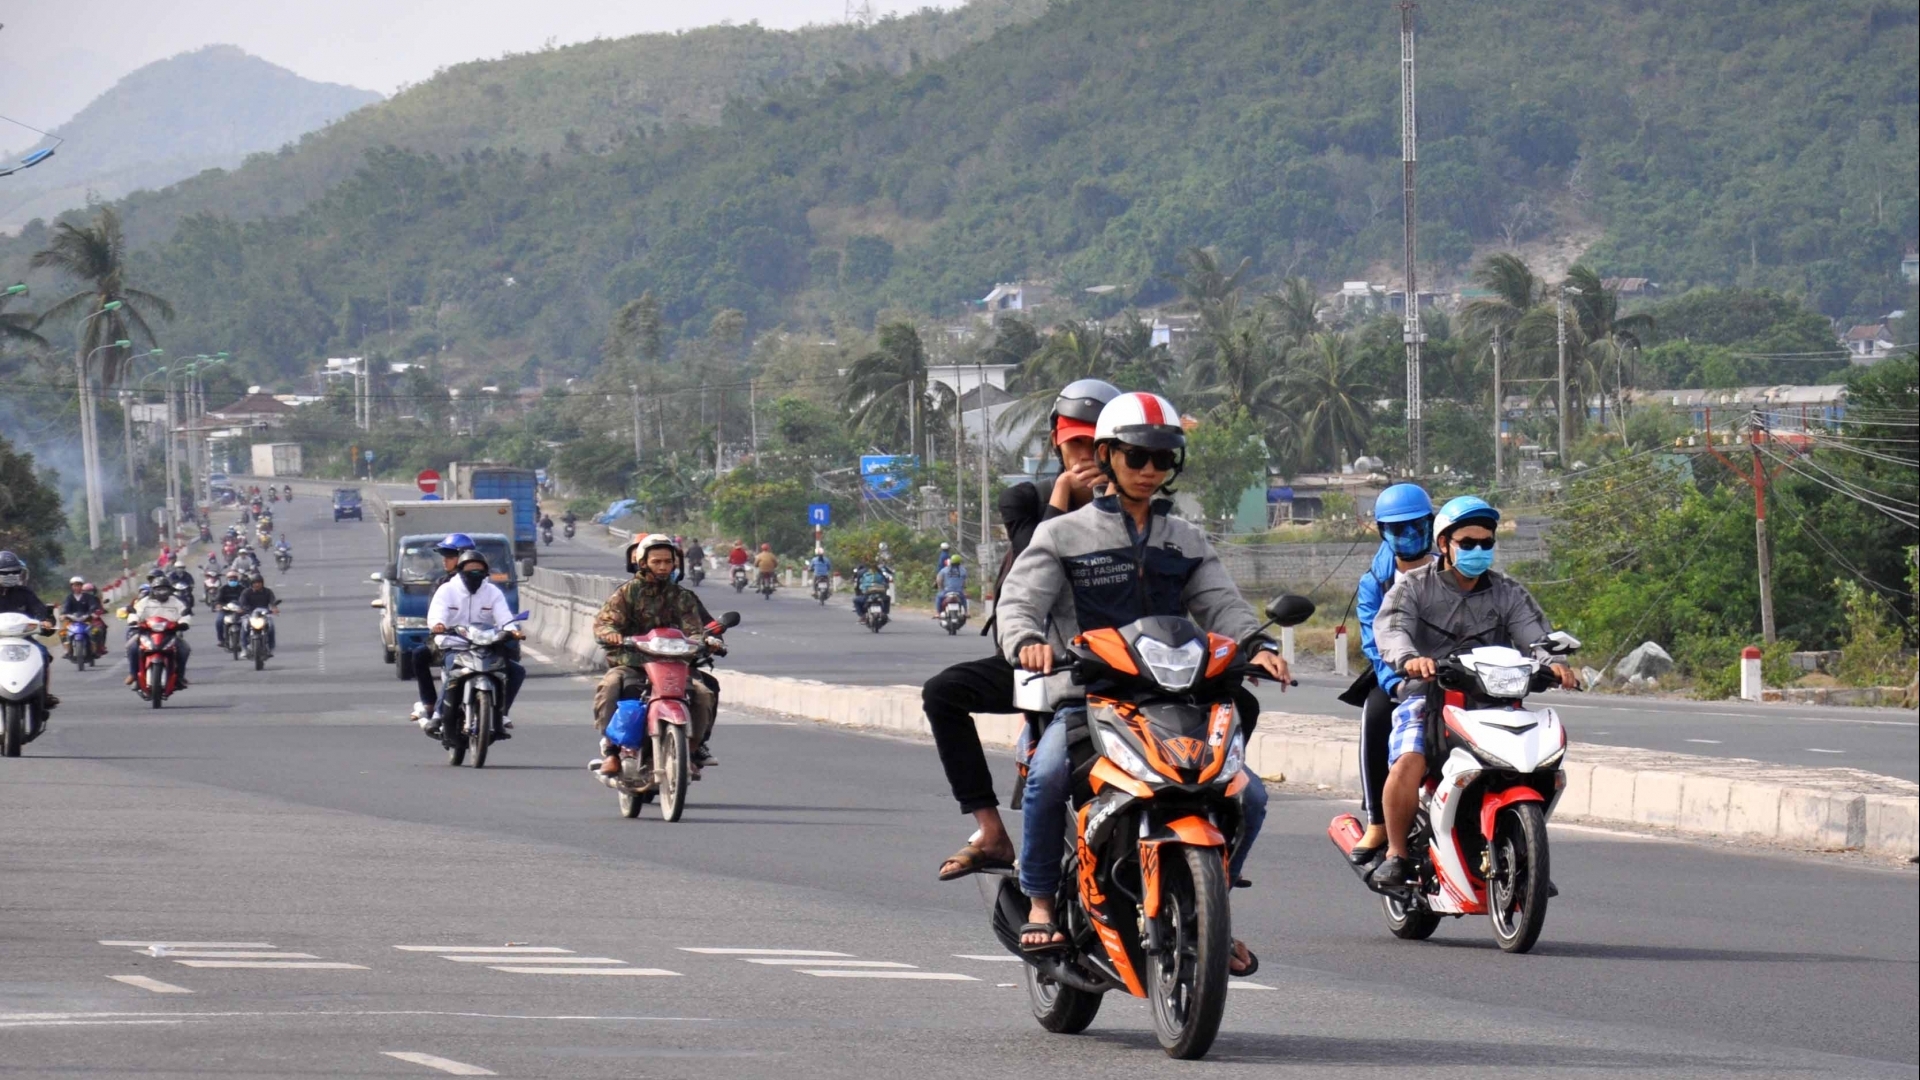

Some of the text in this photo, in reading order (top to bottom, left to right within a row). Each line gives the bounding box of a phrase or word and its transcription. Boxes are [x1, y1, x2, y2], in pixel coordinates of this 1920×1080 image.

[1090, 556, 1113, 566] KIDS
[1094, 563, 1135, 576] FASHION
[1092, 573, 1129, 586] WINTER
